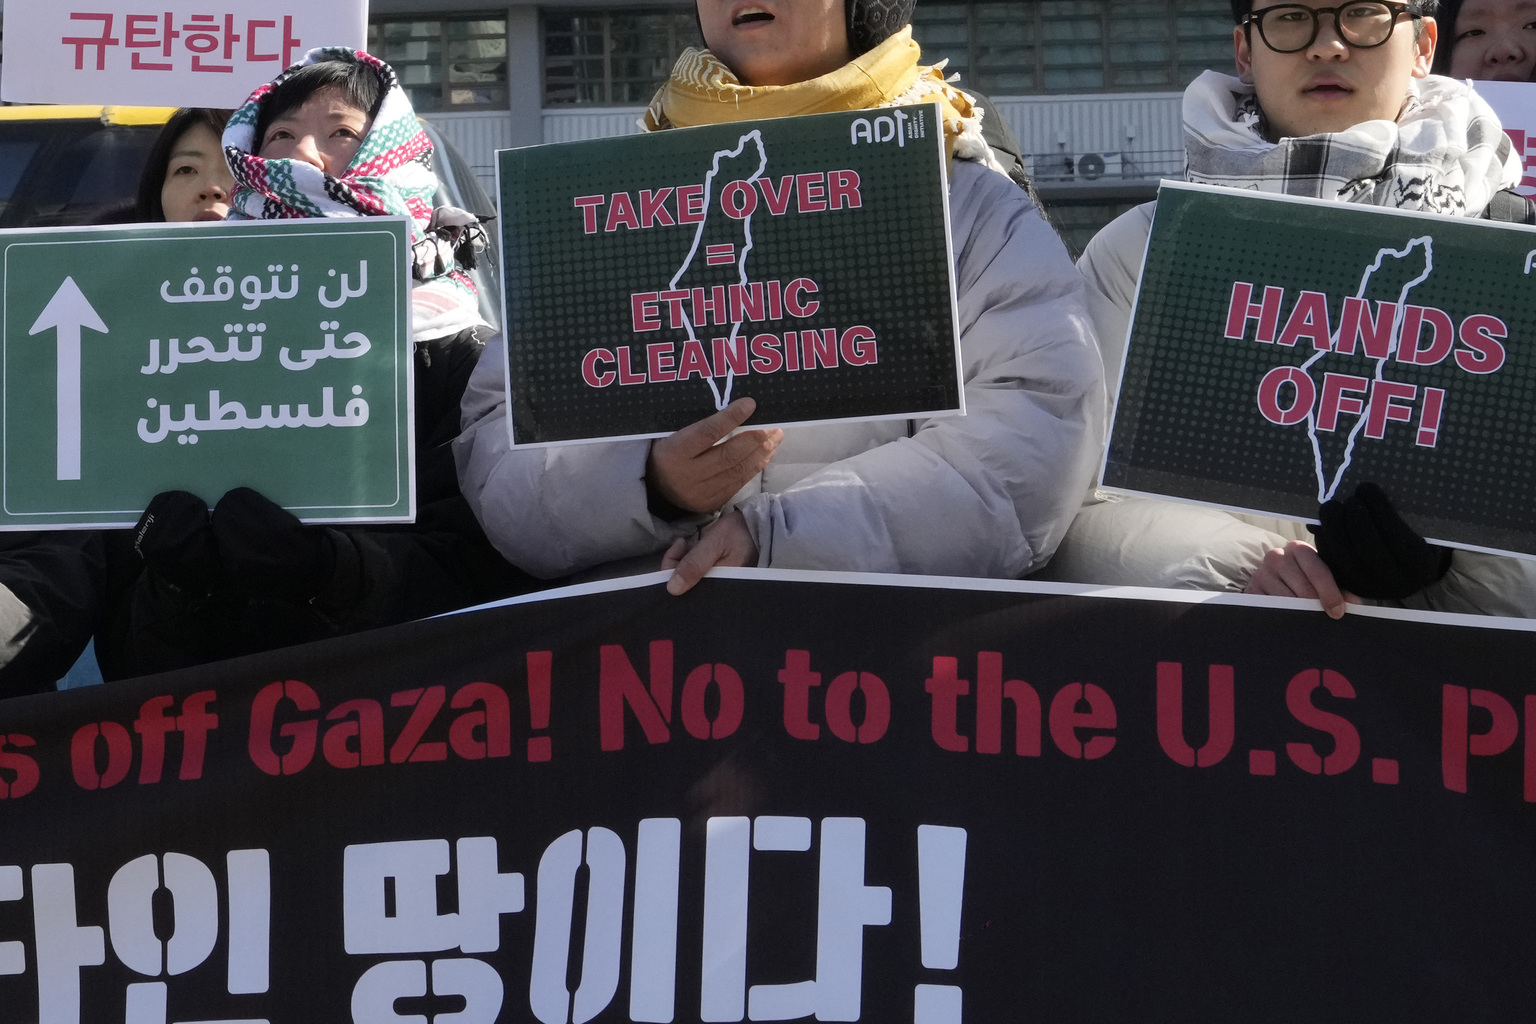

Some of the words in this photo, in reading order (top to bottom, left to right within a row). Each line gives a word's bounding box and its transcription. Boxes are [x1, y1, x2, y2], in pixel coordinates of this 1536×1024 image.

[61, 11, 302, 73] 규탄한다
[573, 184, 706, 235] TAKE
[720, 169, 863, 220] OVER
[159, 262, 300, 311] نتوقف
[317, 259, 369, 309] لن
[630, 277, 821, 333] ETHNIC
[140, 322, 268, 376] تتحرر
[278, 320, 372, 372] حتى
[581, 325, 879, 389] CLEANSING
[1222, 281, 1509, 375] HANDS
[136, 384, 370, 445] فلسطين
[1256, 365, 1446, 449] OFF!
[70, 690, 219, 790] off
[248, 650, 553, 776] Gaza!
[599, 639, 745, 752] No
[777, 649, 891, 744] to
[924, 651, 1118, 760] the
[1156, 661, 1399, 785] U.S.
[343, 815, 968, 1024] 땅이다!
